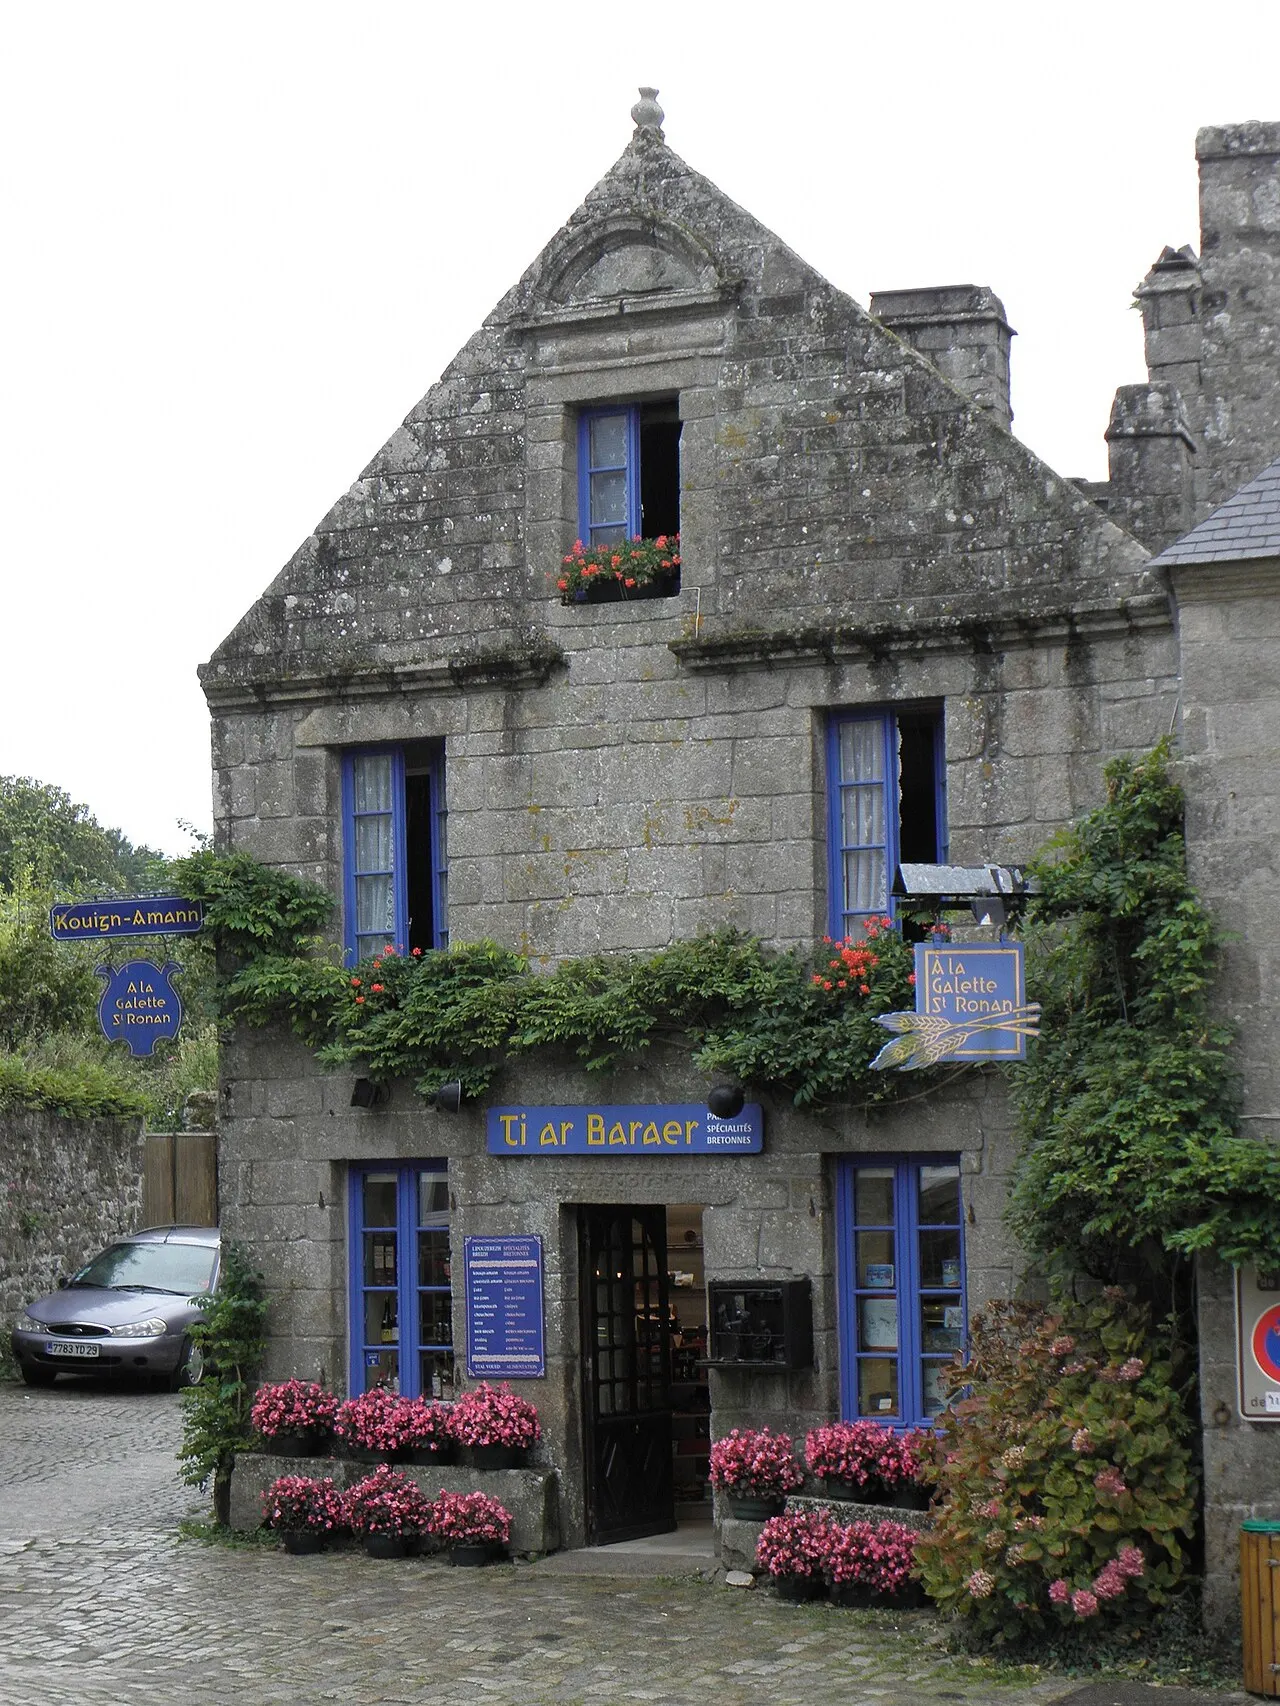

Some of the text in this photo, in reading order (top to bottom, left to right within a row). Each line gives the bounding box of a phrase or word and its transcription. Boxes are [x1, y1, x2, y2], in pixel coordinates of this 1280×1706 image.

[55, 909, 200, 932] Kouign-Amann
[949, 957, 966, 975] la
[140, 981, 153, 994] la
[932, 976, 998, 994] Galette
[116, 996, 166, 1010] Galette
[931, 996, 1013, 1013] St Ronan
[126, 1013, 171, 1025] Ronan
[499, 1113, 700, 1146] Ti ar Baraer
[706, 1122, 752, 1133] SPÉCIALITÉS
[706, 1136, 751, 1145] BRETONNES
[53, 1343, 98, 1356] 7783 YD 29
